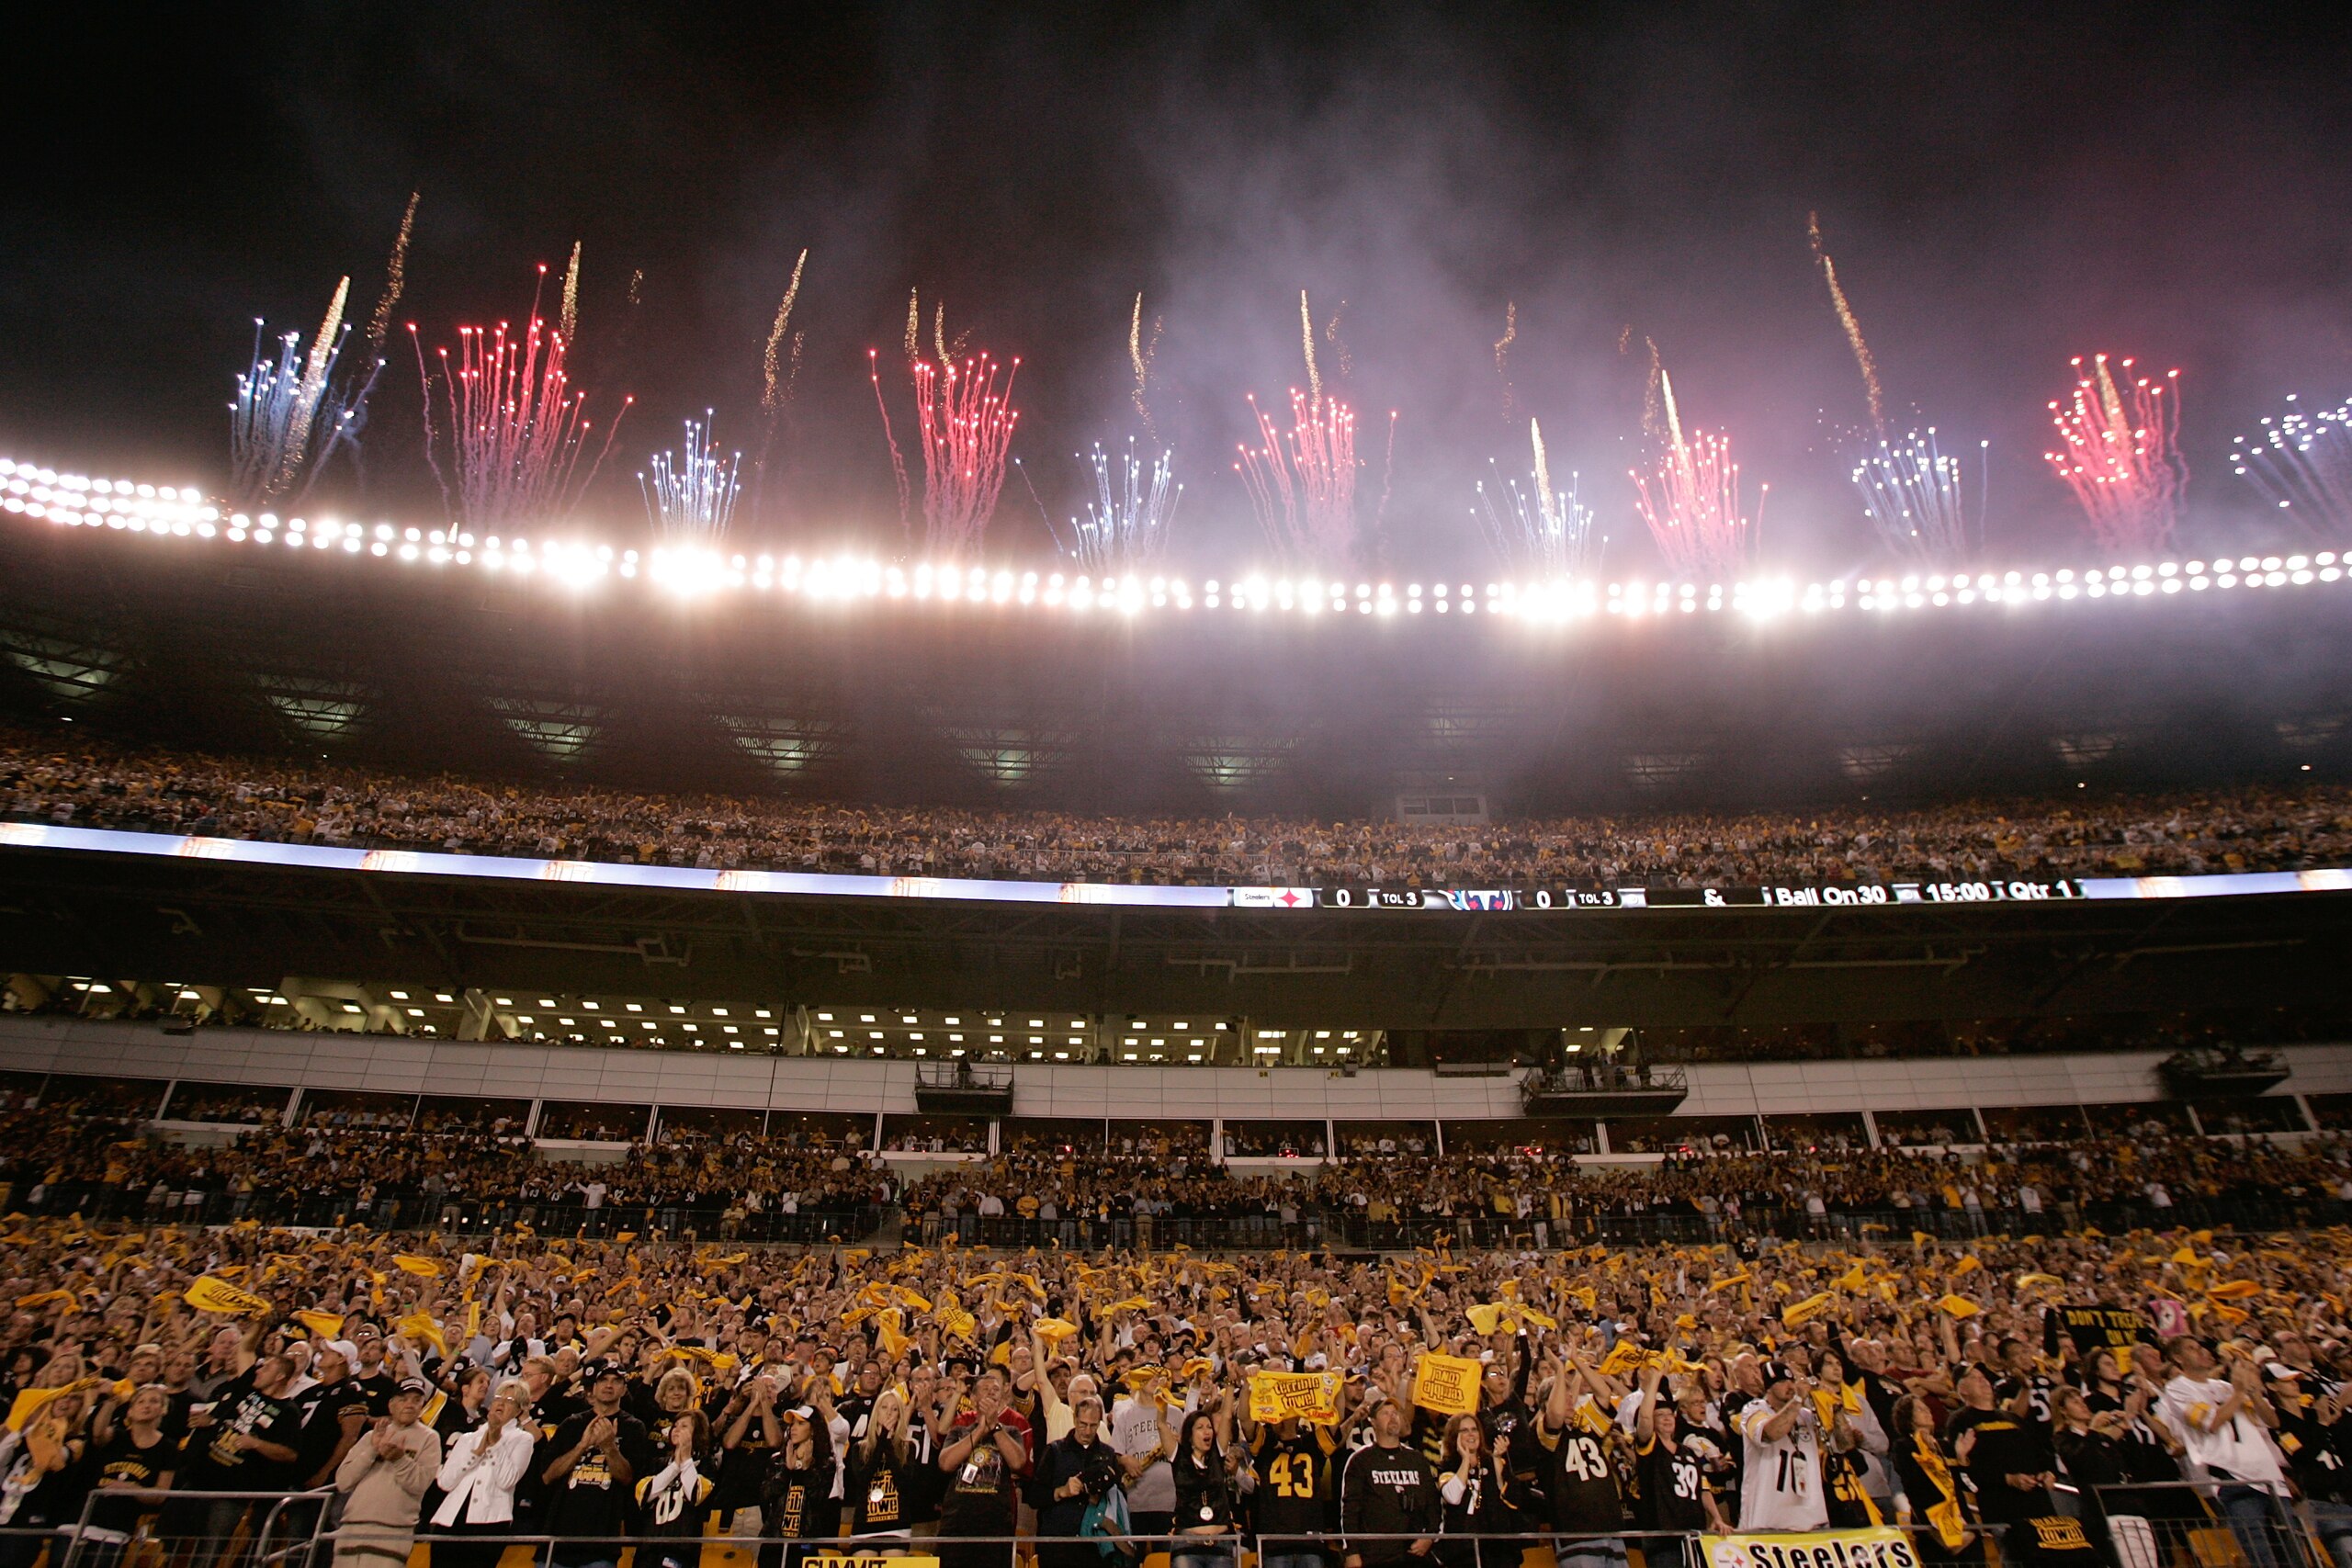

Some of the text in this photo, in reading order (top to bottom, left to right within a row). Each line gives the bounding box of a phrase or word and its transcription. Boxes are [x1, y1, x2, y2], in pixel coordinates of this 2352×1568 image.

[1336, 888, 1351, 907] 0
[1383, 892, 1418, 906] TOL 3
[1536, 890, 1552, 908] 0
[1578, 891, 1614, 906] TOL 3
[1704, 888, 1726, 907] &
[1775, 886, 1820, 906] Ball
[1927, 882, 1991, 902] 15:00
[2008, 879, 2074, 900] Qtr 1
[2106, 1310, 2145, 1328] TREA
[1128, 1420, 1177, 1443] STEEL
[1566, 1437, 1608, 1482] 43
[1270, 1453, 1313, 1498] 43
[1372, 1470, 1420, 1485] STEELERS
[1671, 1461, 1699, 1501] 39
[1747, 1540, 1913, 1568] Steelers
